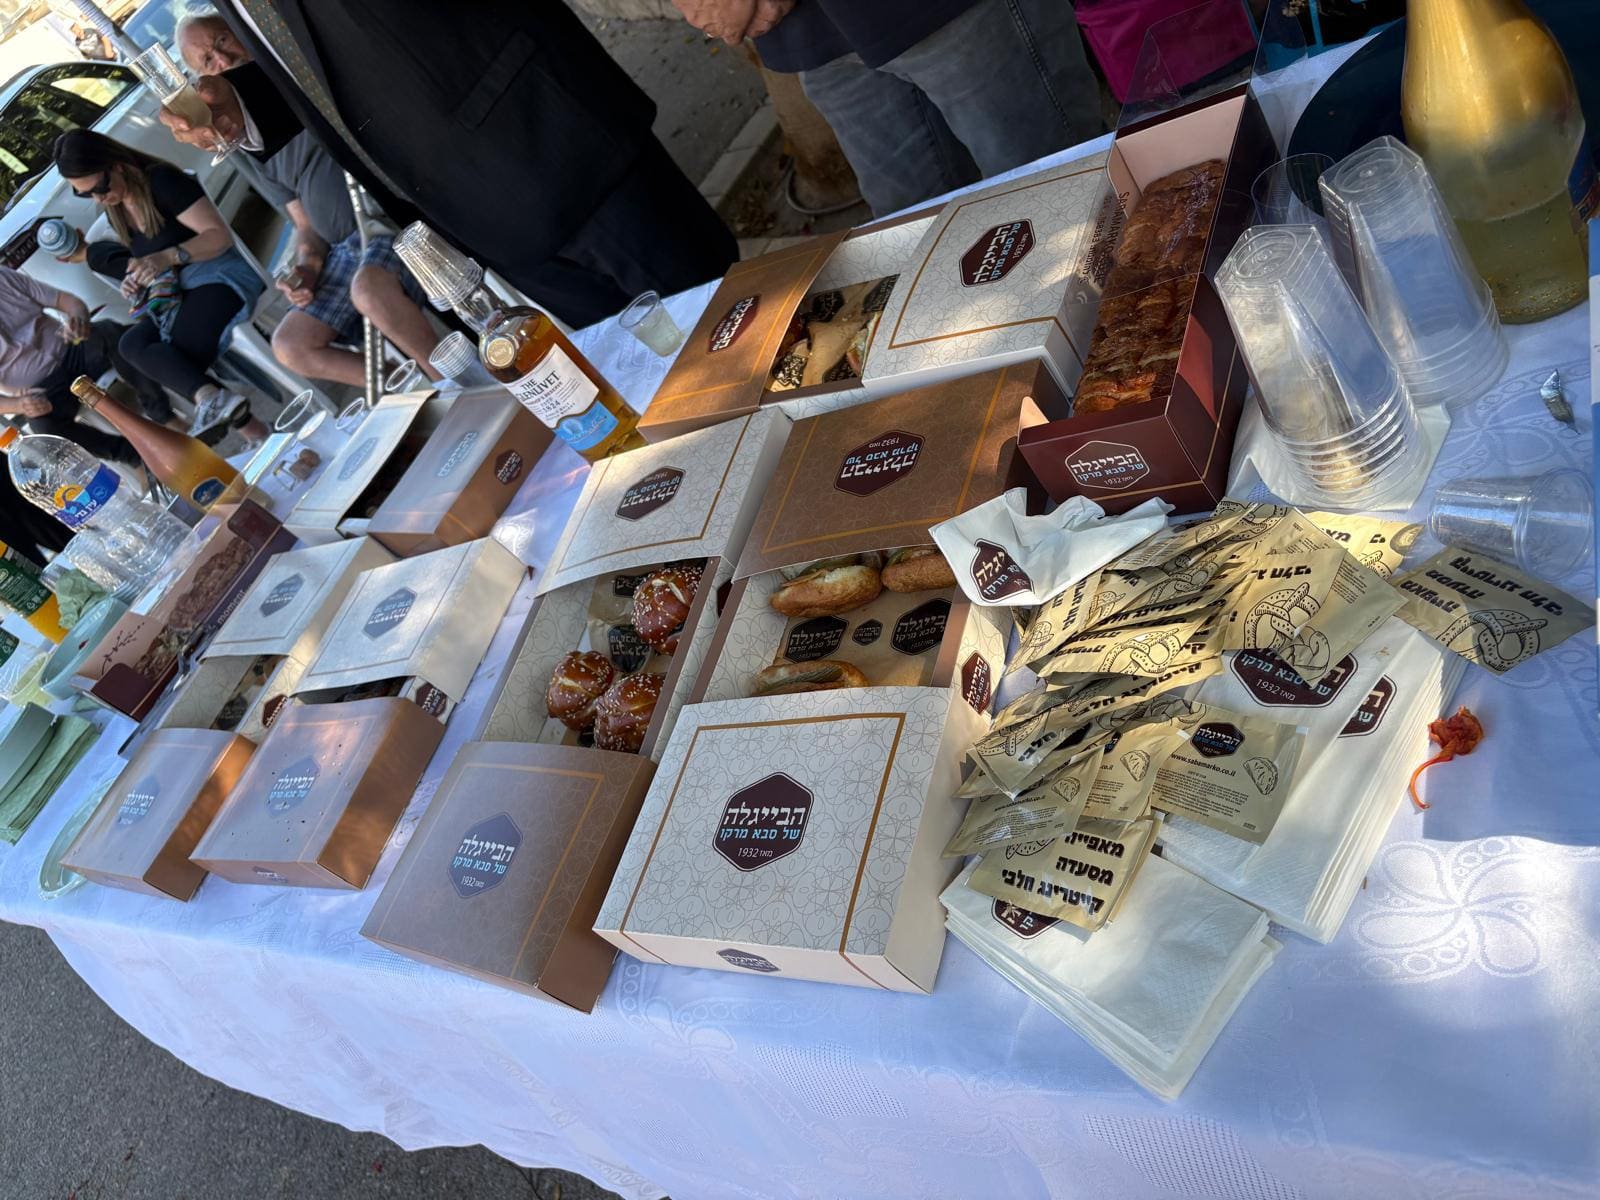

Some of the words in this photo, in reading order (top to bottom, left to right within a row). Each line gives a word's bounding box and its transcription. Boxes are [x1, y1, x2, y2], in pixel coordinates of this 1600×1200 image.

[1008, 223, 1021, 236] של
[972, 225, 1011, 283] הבייגלה
[1000, 237, 1015, 256] סבא
[990, 258, 1005, 280] מרקו
[520, 377, 538, 391] THE
[881, 437, 900, 447] 1932
[845, 455, 861, 465] של
[865, 451, 888, 461] סבא
[892, 442, 919, 456] מרקו
[841, 452, 917, 479] הבייגלה
[1071, 453, 1140, 474] הבייגלה
[1104, 466, 1126, 475] סבא
[1128, 462, 1144, 470] של
[1077, 470, 1103, 481] מרקו
[621, 484, 678, 508] הבייגלה
[983, 574, 1009, 595] מרקו
[1425, 570, 1485, 599] מסעדה
[1450, 556, 1524, 593] קייטרינג
[1519, 589, 1564, 616] חלבי
[1400, 580, 1461, 613] מאפייה
[897, 615, 947, 633] בייגלה
[789, 627, 844, 646] הבייגלה
[1240, 653, 1274, 673] מרקו
[966, 656, 984, 706] הבייגלה
[1256, 678, 1281, 692] 1932
[1279, 690, 1296, 701] מאז
[1017, 730, 1058, 762] חלבי
[1196, 727, 1241, 746] הבייגלה
[1171, 753, 1237, 777] www.sabamarko.co.il
[723, 801, 806, 826] הבייגלה
[720, 828, 748, 841] מרקו
[752, 828, 777, 840] סבא
[782, 826, 801, 840] של
[458, 834, 515, 862] הבייגלה
[738, 847, 759, 858] 1932
[759, 849, 774, 857] מאז
[1064, 831, 1125, 858] מאפייה
[453, 856, 473, 868] מרקו
[473, 859, 492, 871] סבא
[493, 861, 507, 874] של
[1055, 856, 1115, 886] מסעדה
[1002, 868, 1035, 892] חלבי
[1036, 880, 1105, 916] קייטרינג
